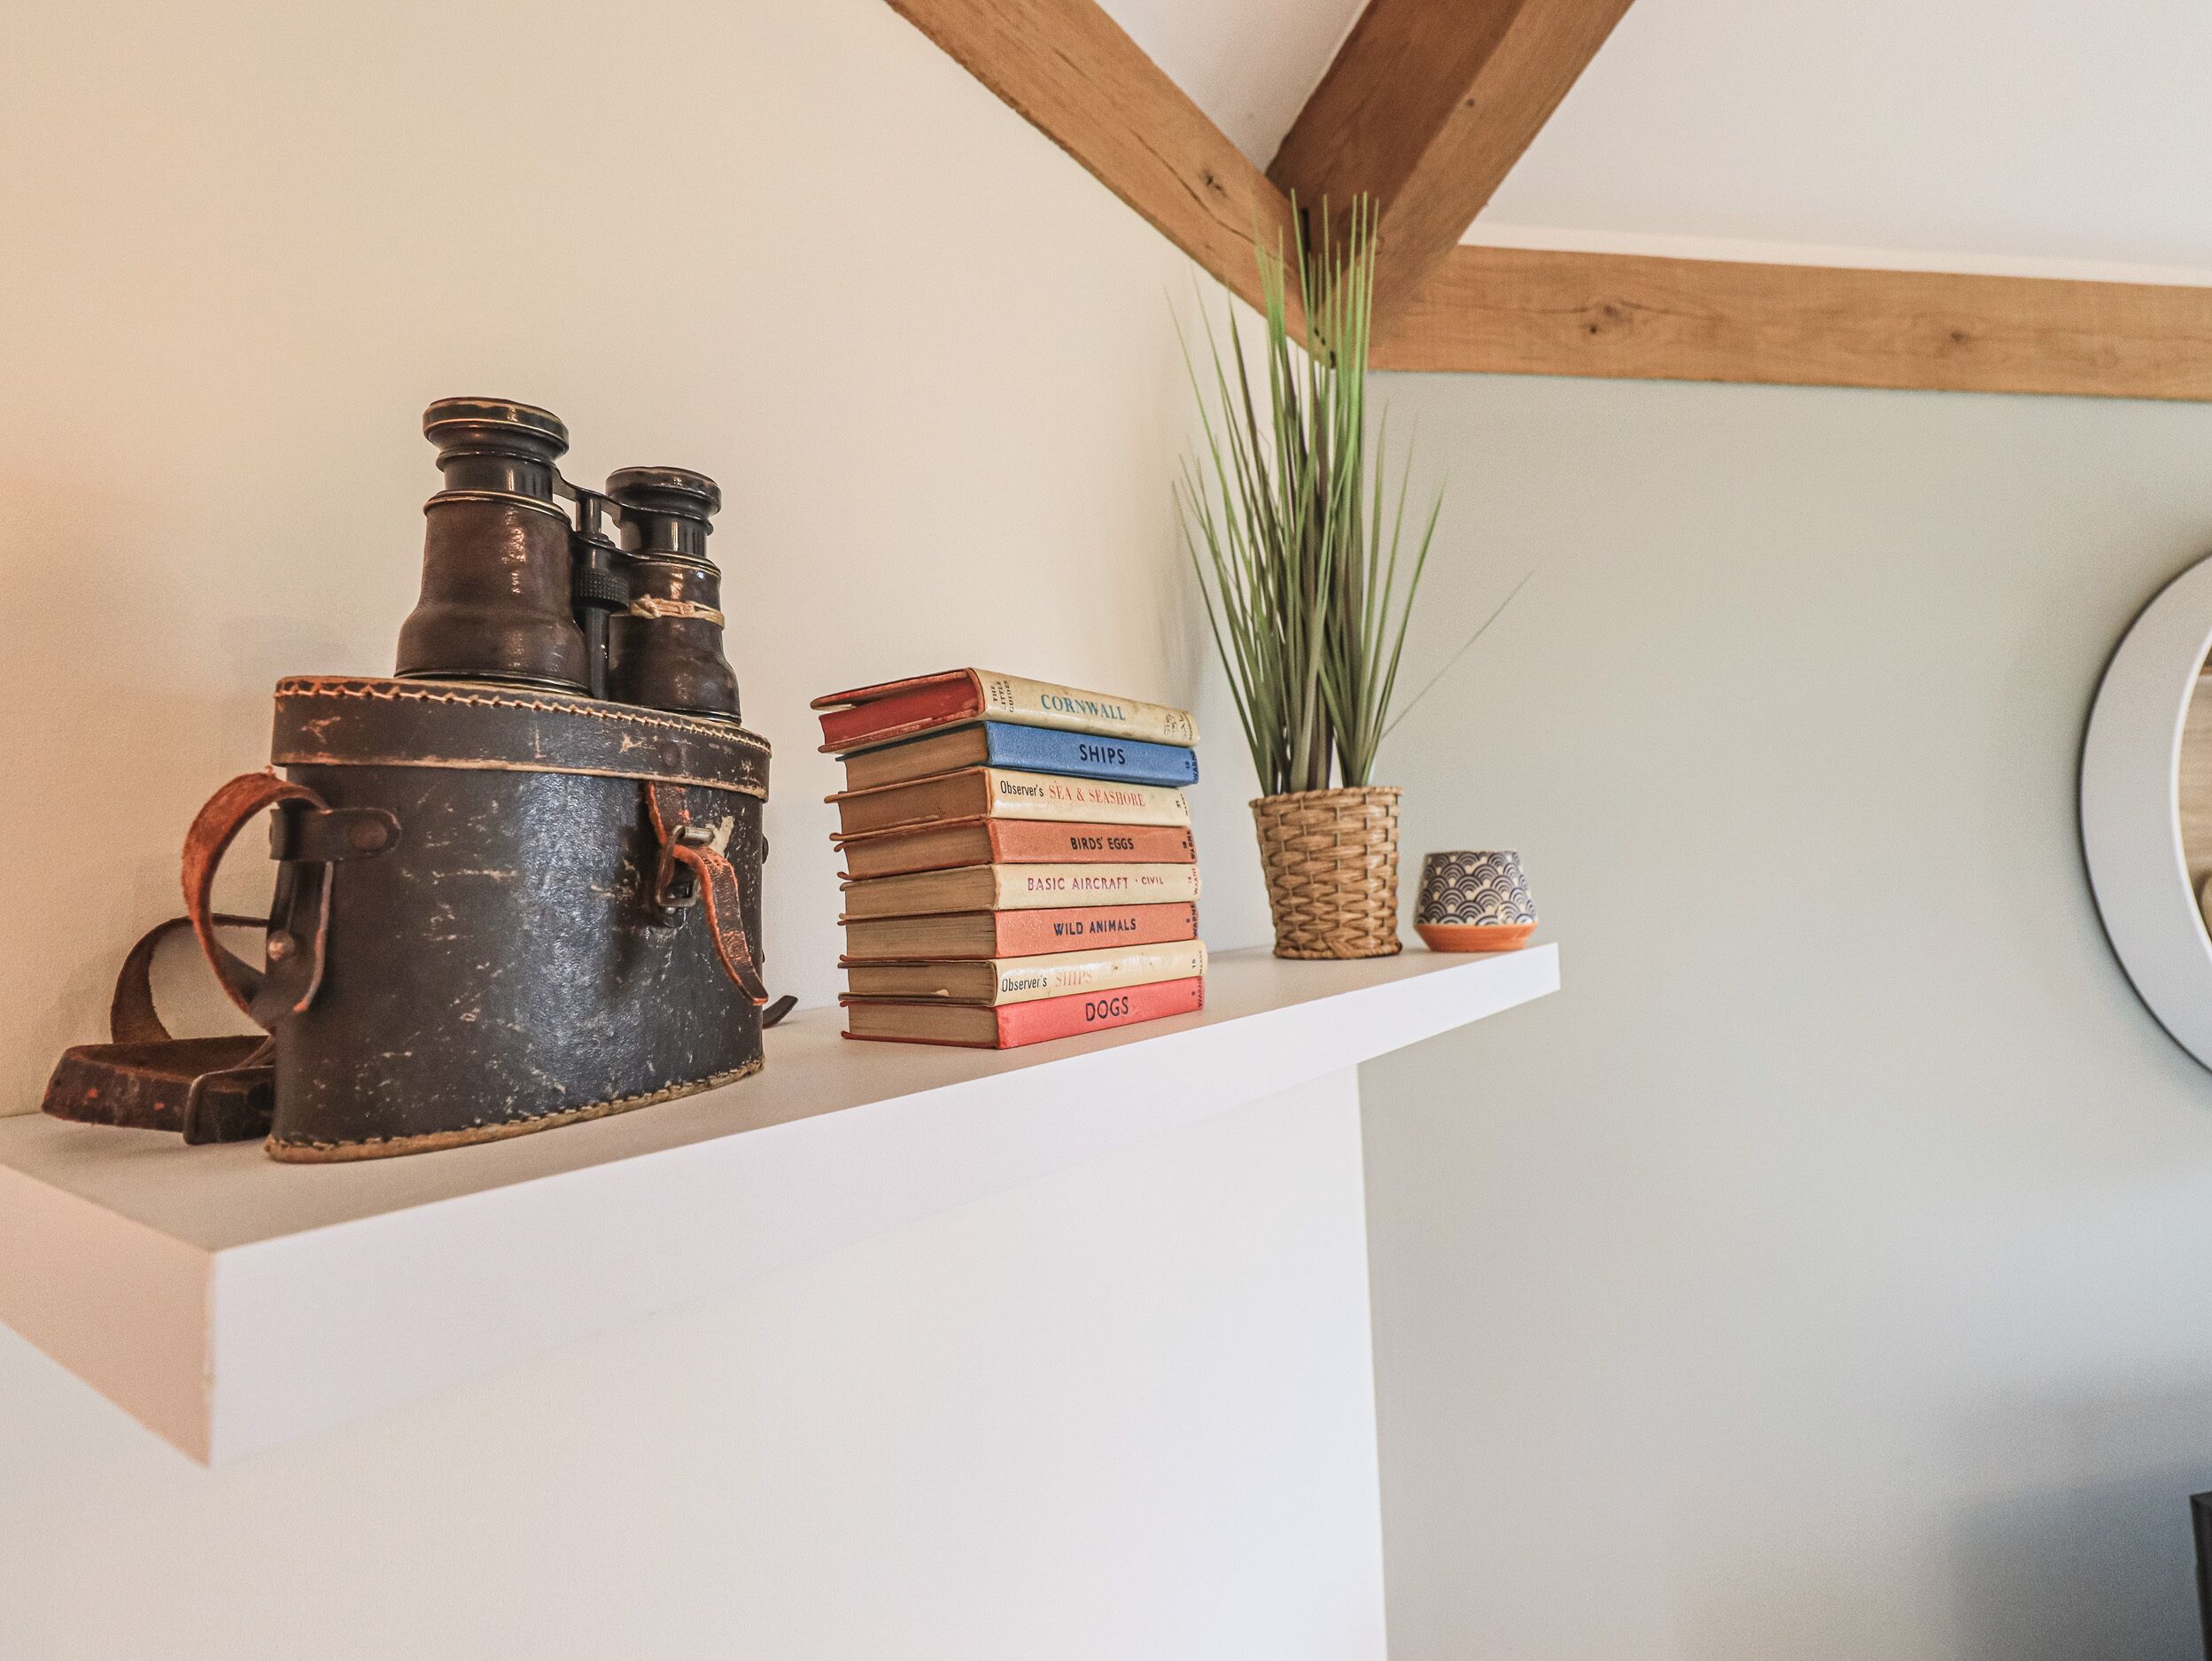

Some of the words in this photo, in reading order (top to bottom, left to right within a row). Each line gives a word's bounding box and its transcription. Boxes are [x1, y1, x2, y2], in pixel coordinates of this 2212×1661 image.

[1003, 680, 1013, 712] GUIDES
[1041, 694, 1126, 721] CORNWALL
[1079, 744, 1126, 765] SHIPS
[1000, 780, 1044, 797] Observer's
[1049, 784, 1073, 801] SEA
[1076, 788, 1085, 802] &
[1089, 788, 1145, 807] SEASHORE
[1108, 836, 1134, 850] EGGS
[1028, 877, 1066, 891] BASIC
[1072, 876, 1129, 890] AIRCRAFT
[1141, 876, 1164, 886] CIVIL
[1054, 922, 1083, 936] WILD
[1090, 918, 1137, 934] ANIMALS
[1001, 974, 1048, 993] Observer's
[1055, 970, 1093, 988] SHIPS
[1085, 997, 1129, 1022] DOGS
